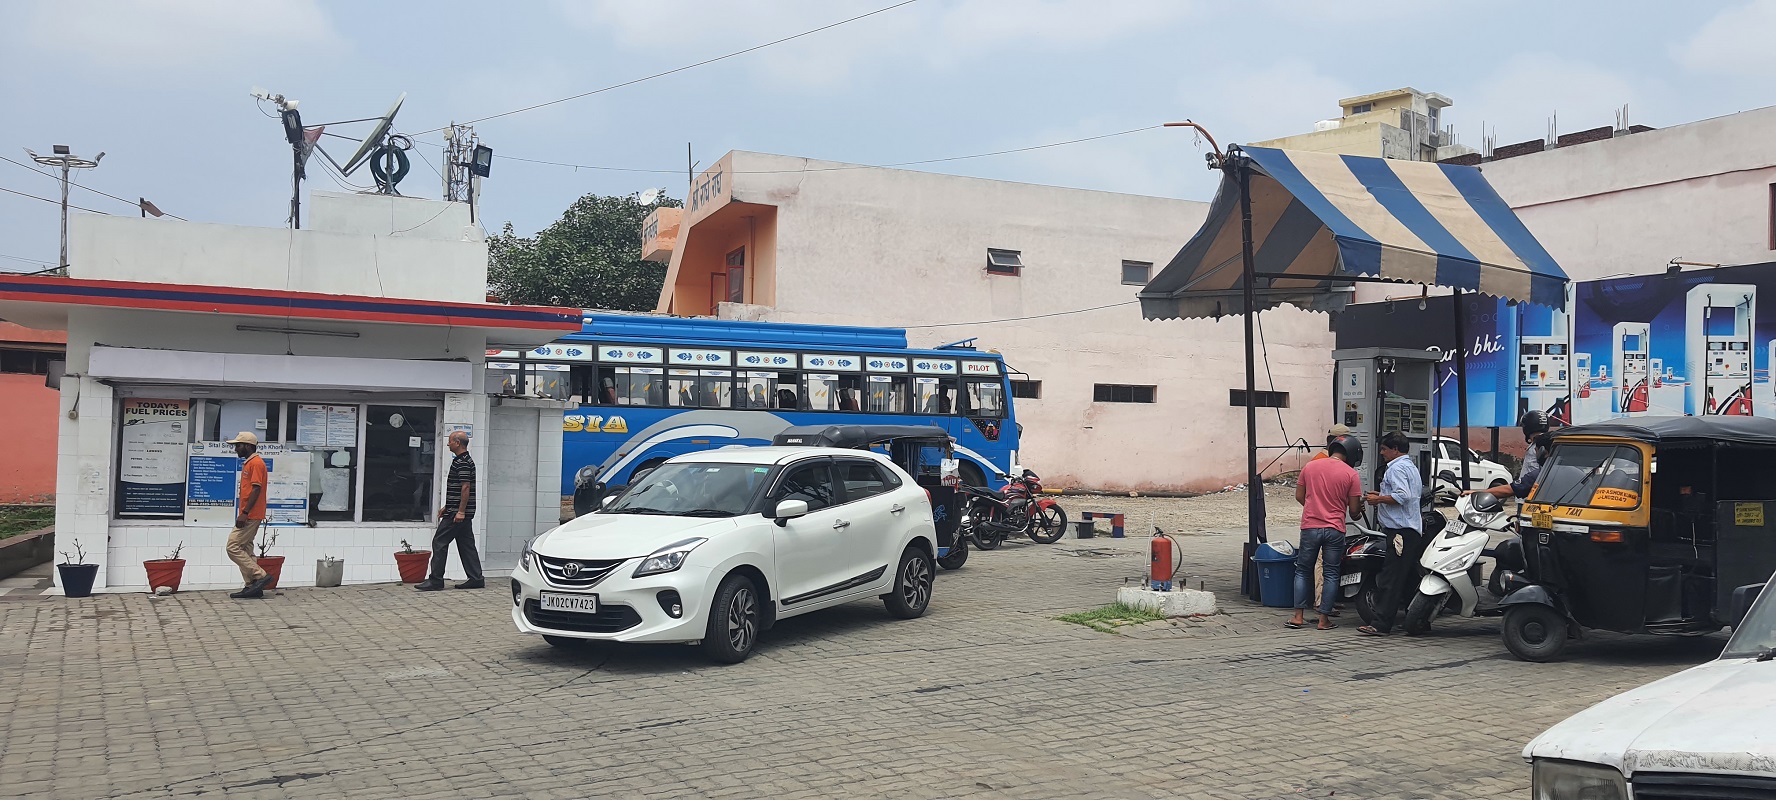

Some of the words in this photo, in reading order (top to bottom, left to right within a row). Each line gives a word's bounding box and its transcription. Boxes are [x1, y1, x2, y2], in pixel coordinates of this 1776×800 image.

[136, 401, 179, 409] TODAY'S
[125, 407, 150, 415] FUEL
[1566, 507, 1583, 517] TAXI
